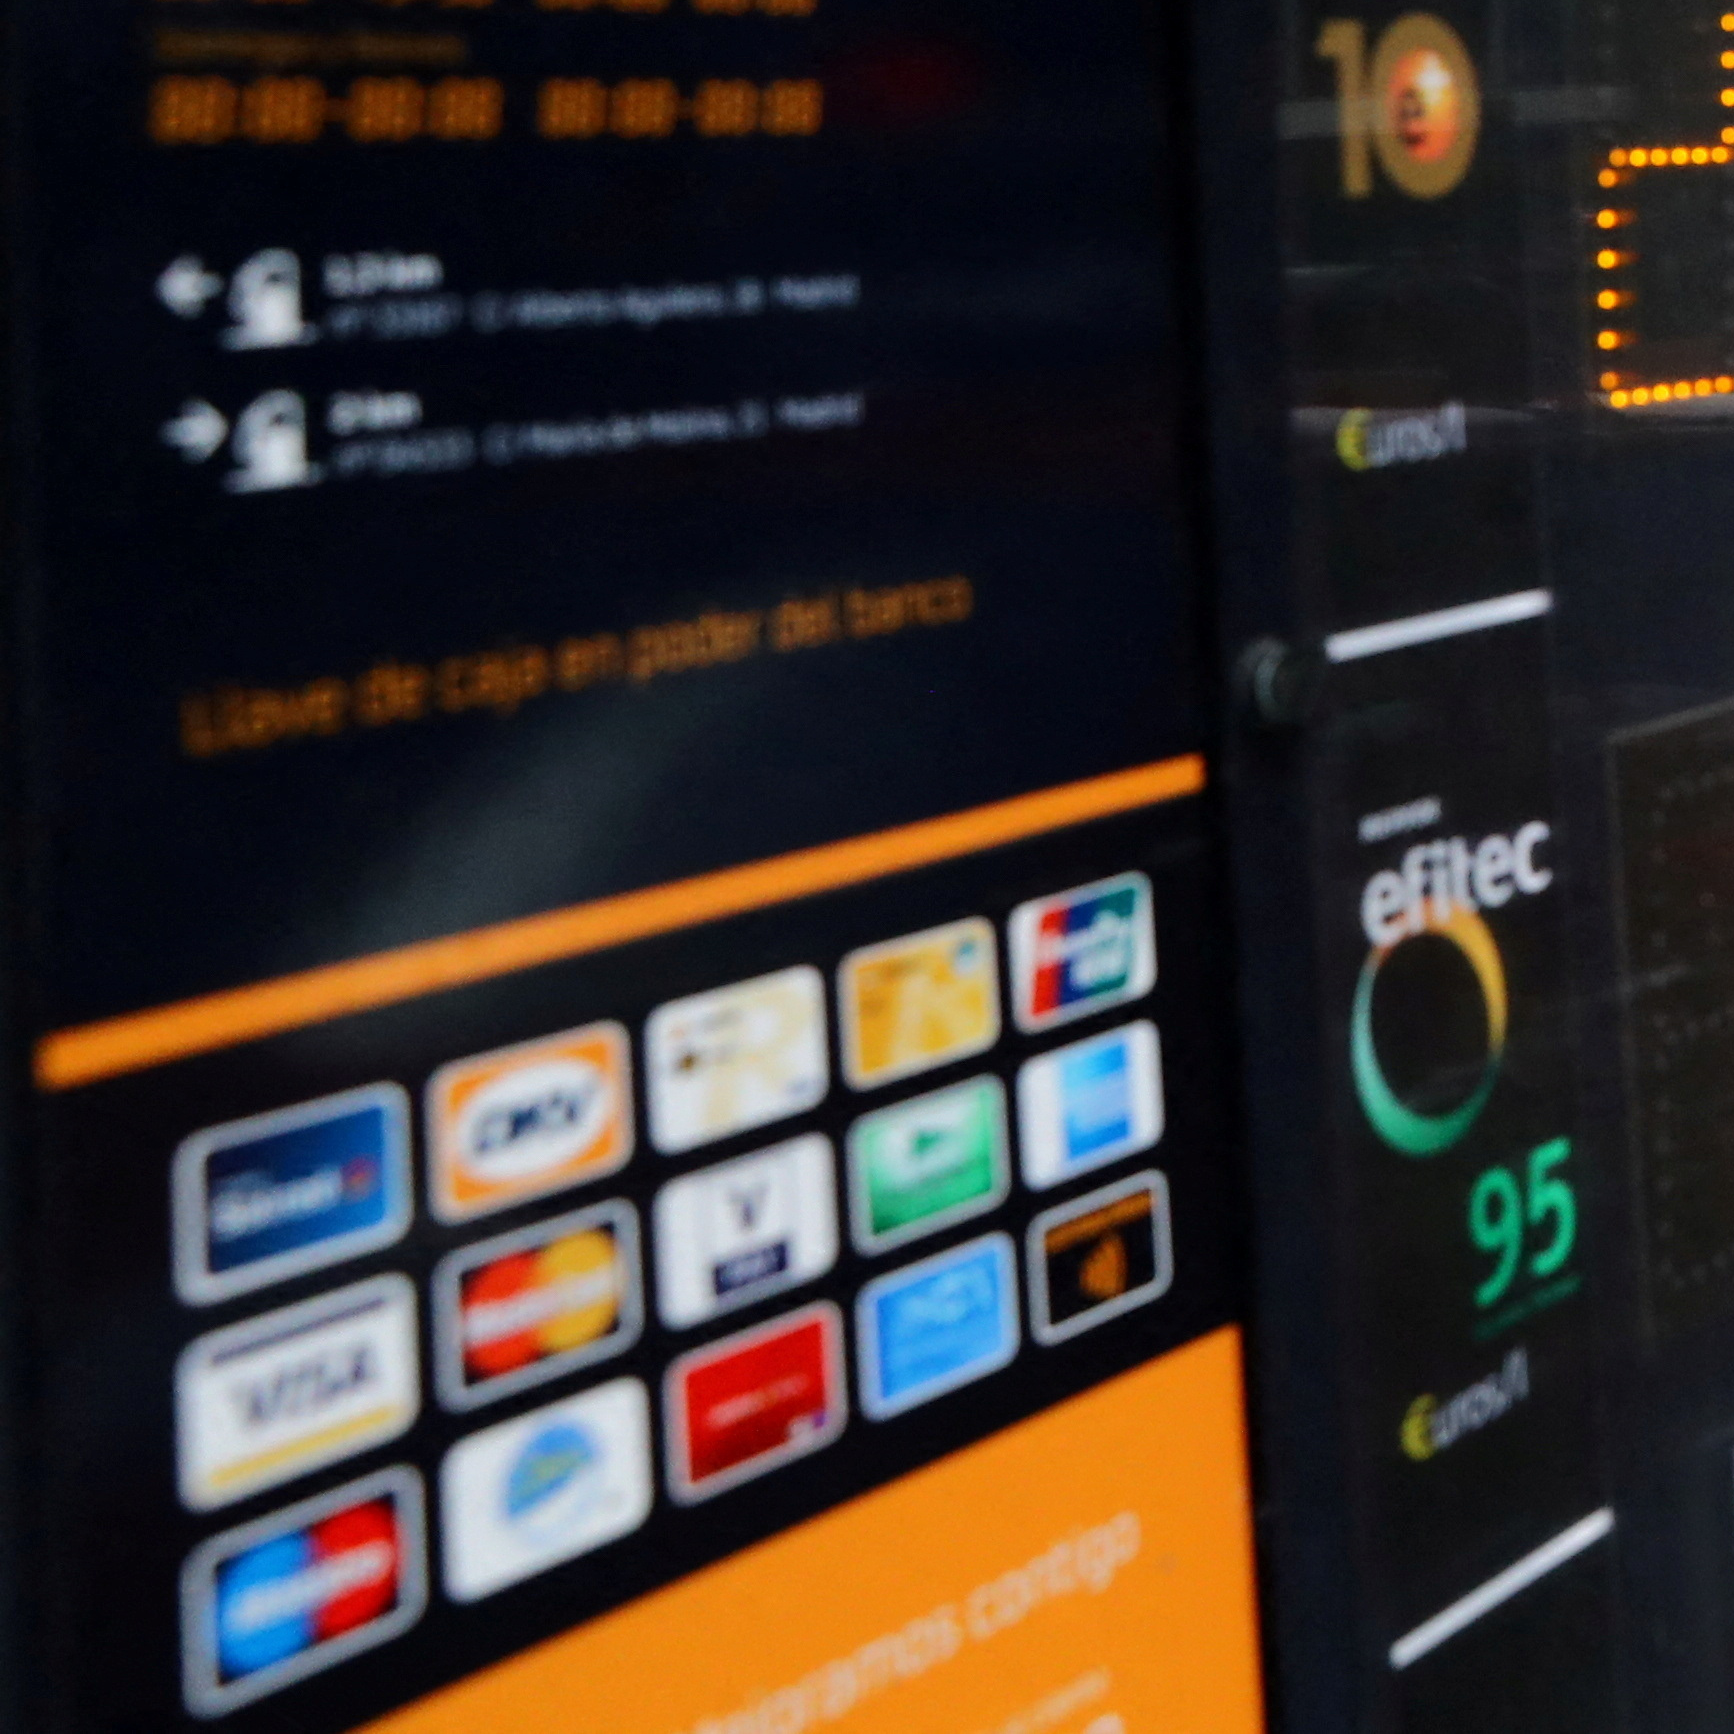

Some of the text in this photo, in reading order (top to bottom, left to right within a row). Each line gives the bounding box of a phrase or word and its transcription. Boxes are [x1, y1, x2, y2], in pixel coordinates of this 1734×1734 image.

[1316, 12, 1481, 198] 10
[1360, 820, 1553, 947] efitec
[1467, 1138, 1577, 1311] 95
